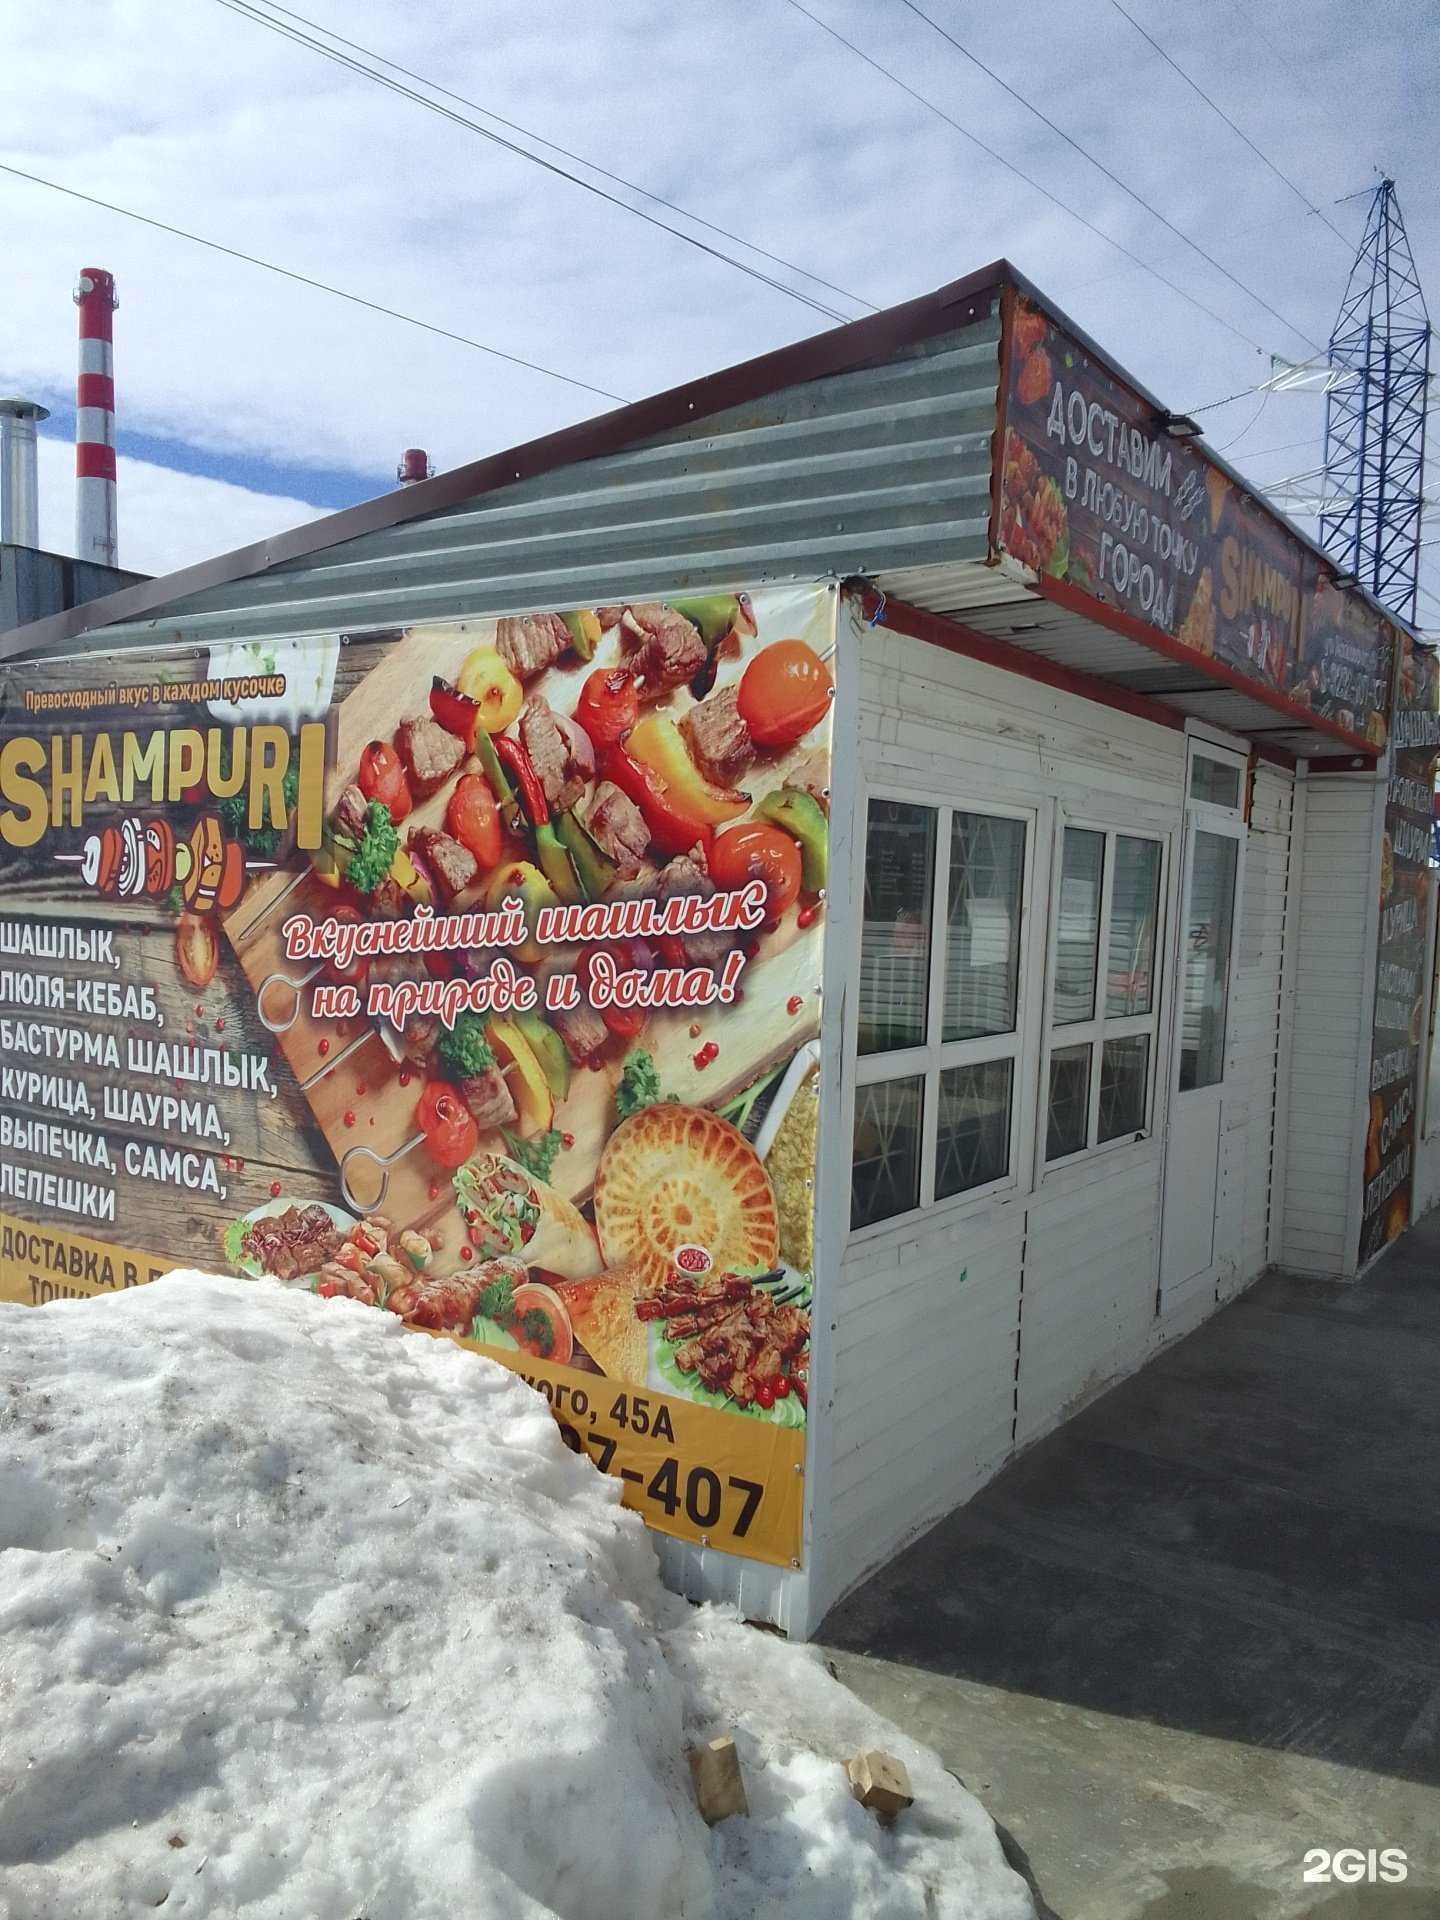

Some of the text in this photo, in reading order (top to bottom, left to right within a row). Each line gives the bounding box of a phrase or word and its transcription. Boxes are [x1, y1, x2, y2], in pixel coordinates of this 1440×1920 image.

[1047, 381, 1173, 497] ДОСТАВИМ
[1065, 456, 1078, 499] В
[1081, 468, 1149, 545] ЛЮБУЮ
[1100, 531, 1175, 631] ГОРОДА
[25, 675, 286, 713] Превосходный вкус в каждом кусочке
[0, 722, 326, 850] SHAMPURI
[0, 922, 121, 970] ШАШЛЫК,
[283, 879, 767, 969] Вкуснейший шашлык
[0, 971, 164, 1028] ЛЮЛЯ-КЕБАБ,
[311, 951, 746, 1032] на природе и дома!
[0, 1019, 278, 1099] БАСТУРМА ШАШЛЫК,
[2, 1066, 231, 1146] КУРИЦА, ШАУРМА,
[0, 1115, 228, 1200] ВЫПЕЧКА, САМСА,
[0, 1163, 116, 1222] ЛЕПЕШКИ
[2, 1226, 116, 1288] ДОСТАВКА
